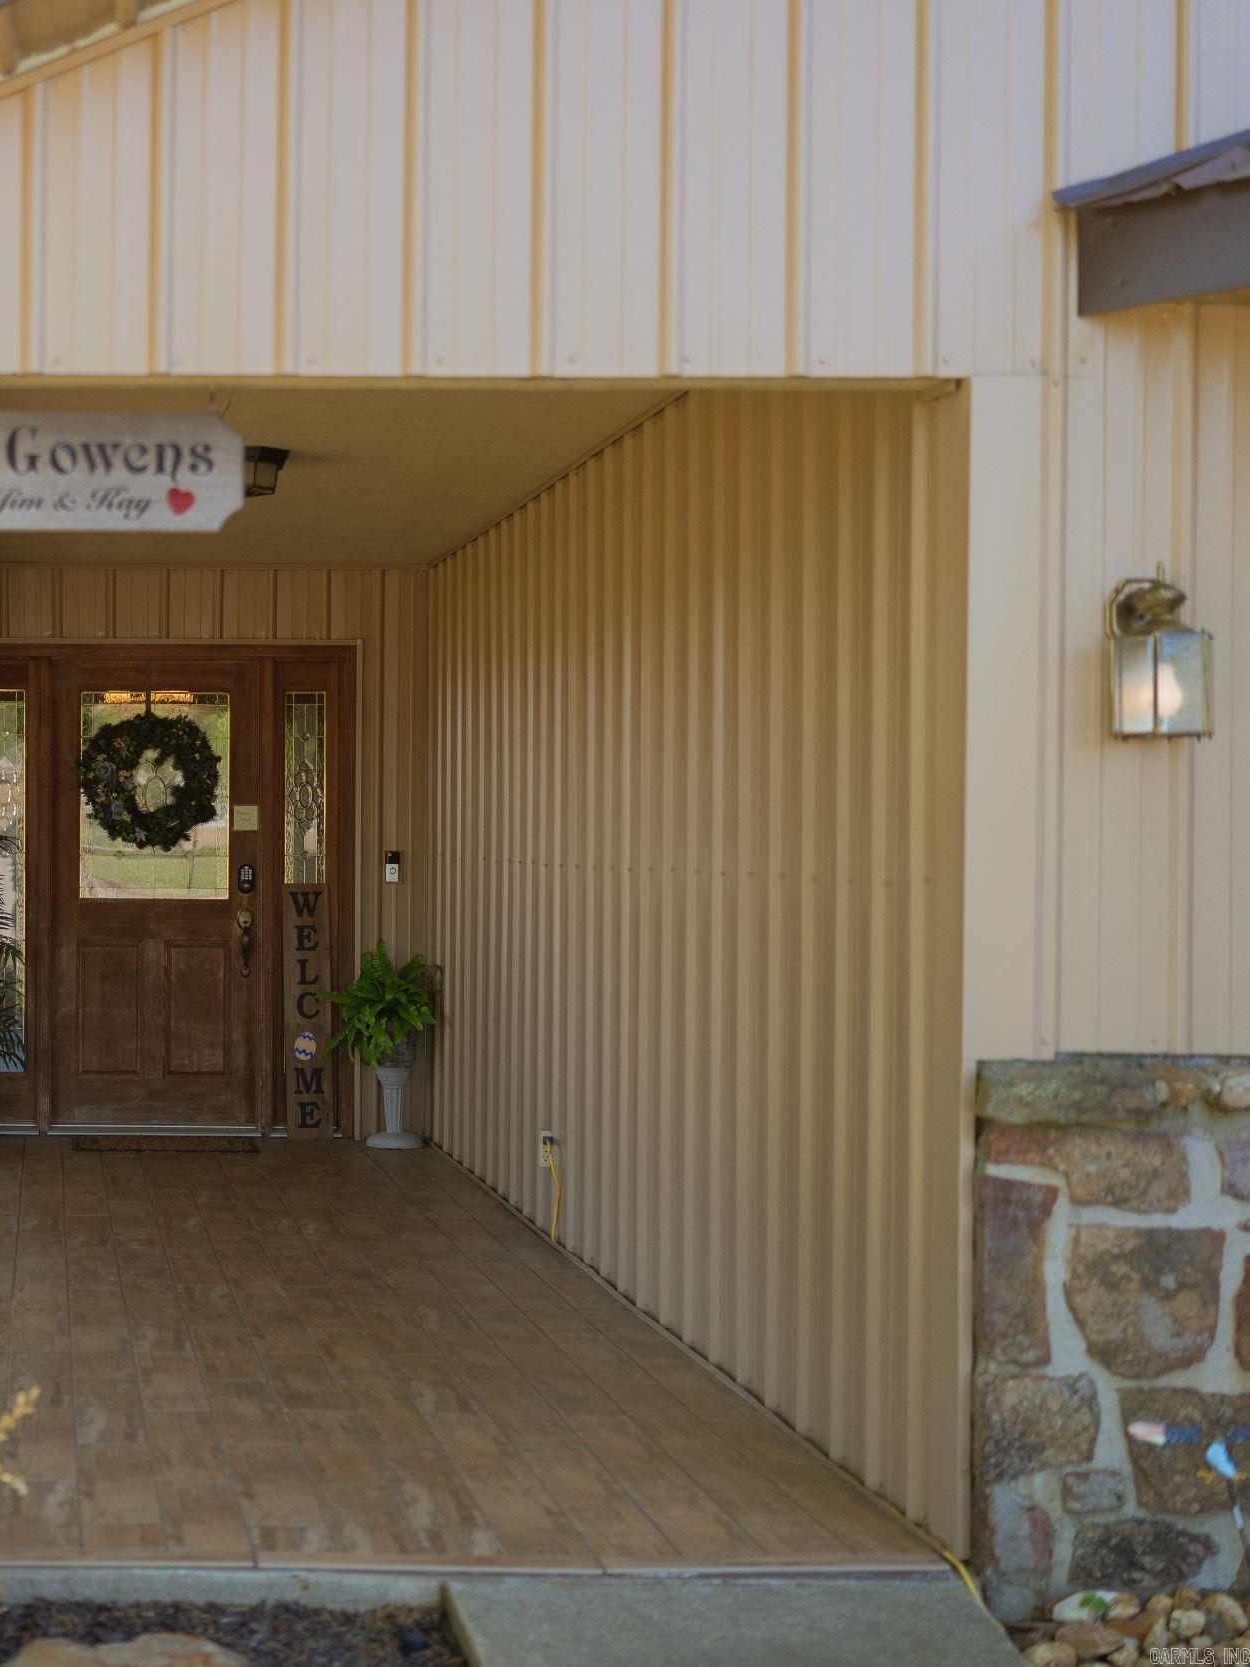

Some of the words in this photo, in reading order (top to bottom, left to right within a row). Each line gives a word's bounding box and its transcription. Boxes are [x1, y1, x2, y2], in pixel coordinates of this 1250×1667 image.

[5, 424, 214, 482] Gowens
[52, 489, 78, 512] &
[85, 486, 152, 521] Kay
